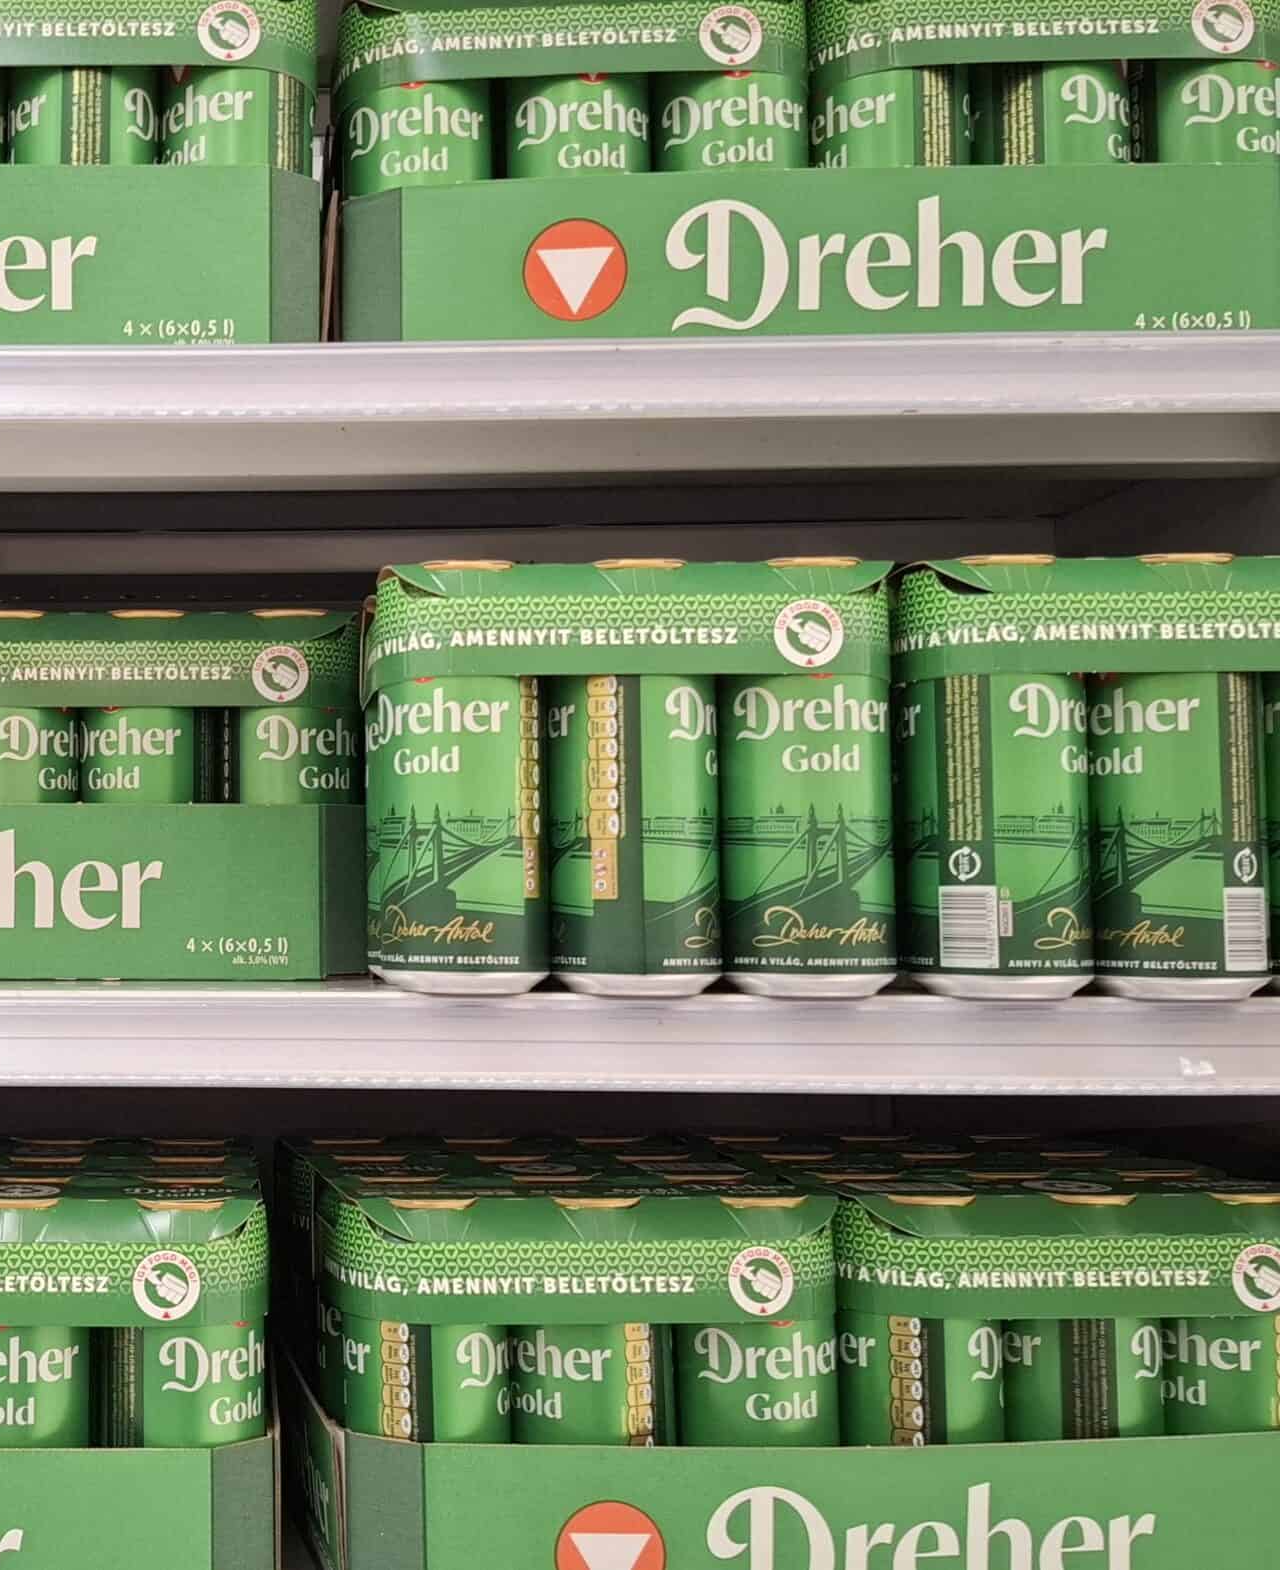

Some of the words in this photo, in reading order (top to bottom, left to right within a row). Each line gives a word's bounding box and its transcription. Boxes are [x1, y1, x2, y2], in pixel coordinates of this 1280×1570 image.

[42, 18, 175, 37] BELETÖLTESZ
[818, 32, 881, 65] VILÁG,
[891, 22, 1006, 43] AMENNYIT
[1012, 18, 1159, 37] BELETÖLTESZ
[363, 37, 425, 64] VILÁG,
[431, 33, 535, 51] AMENNYIT
[542, 28, 677, 48] BELETÖLTESZ
[349, 93, 483, 160] Dreher
[662, 83, 803, 151] Dreher
[380, 147, 448, 176] Gold
[558, 143, 625, 169] Gold
[702, 136, 773, 167] Gold
[665, 195, 1109, 333] Dreher
[123, 319, 133, 336] 4
[1135, 312, 1146, 329] 4
[384, 630, 442, 654] VILÁG,
[450, 629, 570, 647] AMENNYIT
[581, 625, 737, 645] BELETÖLTESZ
[928, 634, 941, 648] A
[946, 623, 1024, 645] VILÁG,
[1033, 623, 1153, 641] AMENNYIT
[11, 666, 106, 681] AMENNYIT
[111, 664, 231, 681] BELETÖLTESZ
[733, 684, 888, 741] Dreher
[394, 745, 460, 775] Gold
[782, 743, 860, 772] Gold
[88, 766, 140, 790] Gold
[299, 766, 350, 790] Gold
[186, 937, 195, 952] 4
[347, 1271, 408, 1295] VILÁG,
[417, 1277, 535, 1295] AMENNYIT
[544, 1274, 694, 1294] BELETÖLTESZ
[858, 1266, 869, 1282] A
[876, 1267, 951, 1290] VILÁG,
[958, 1271, 1066, 1288] AMENNYIT
[1073, 1267, 1210, 1287] BELETÖLTESZ
[208, 1387, 261, 1425] Gold
[746, 1390, 818, 1421] Gold
